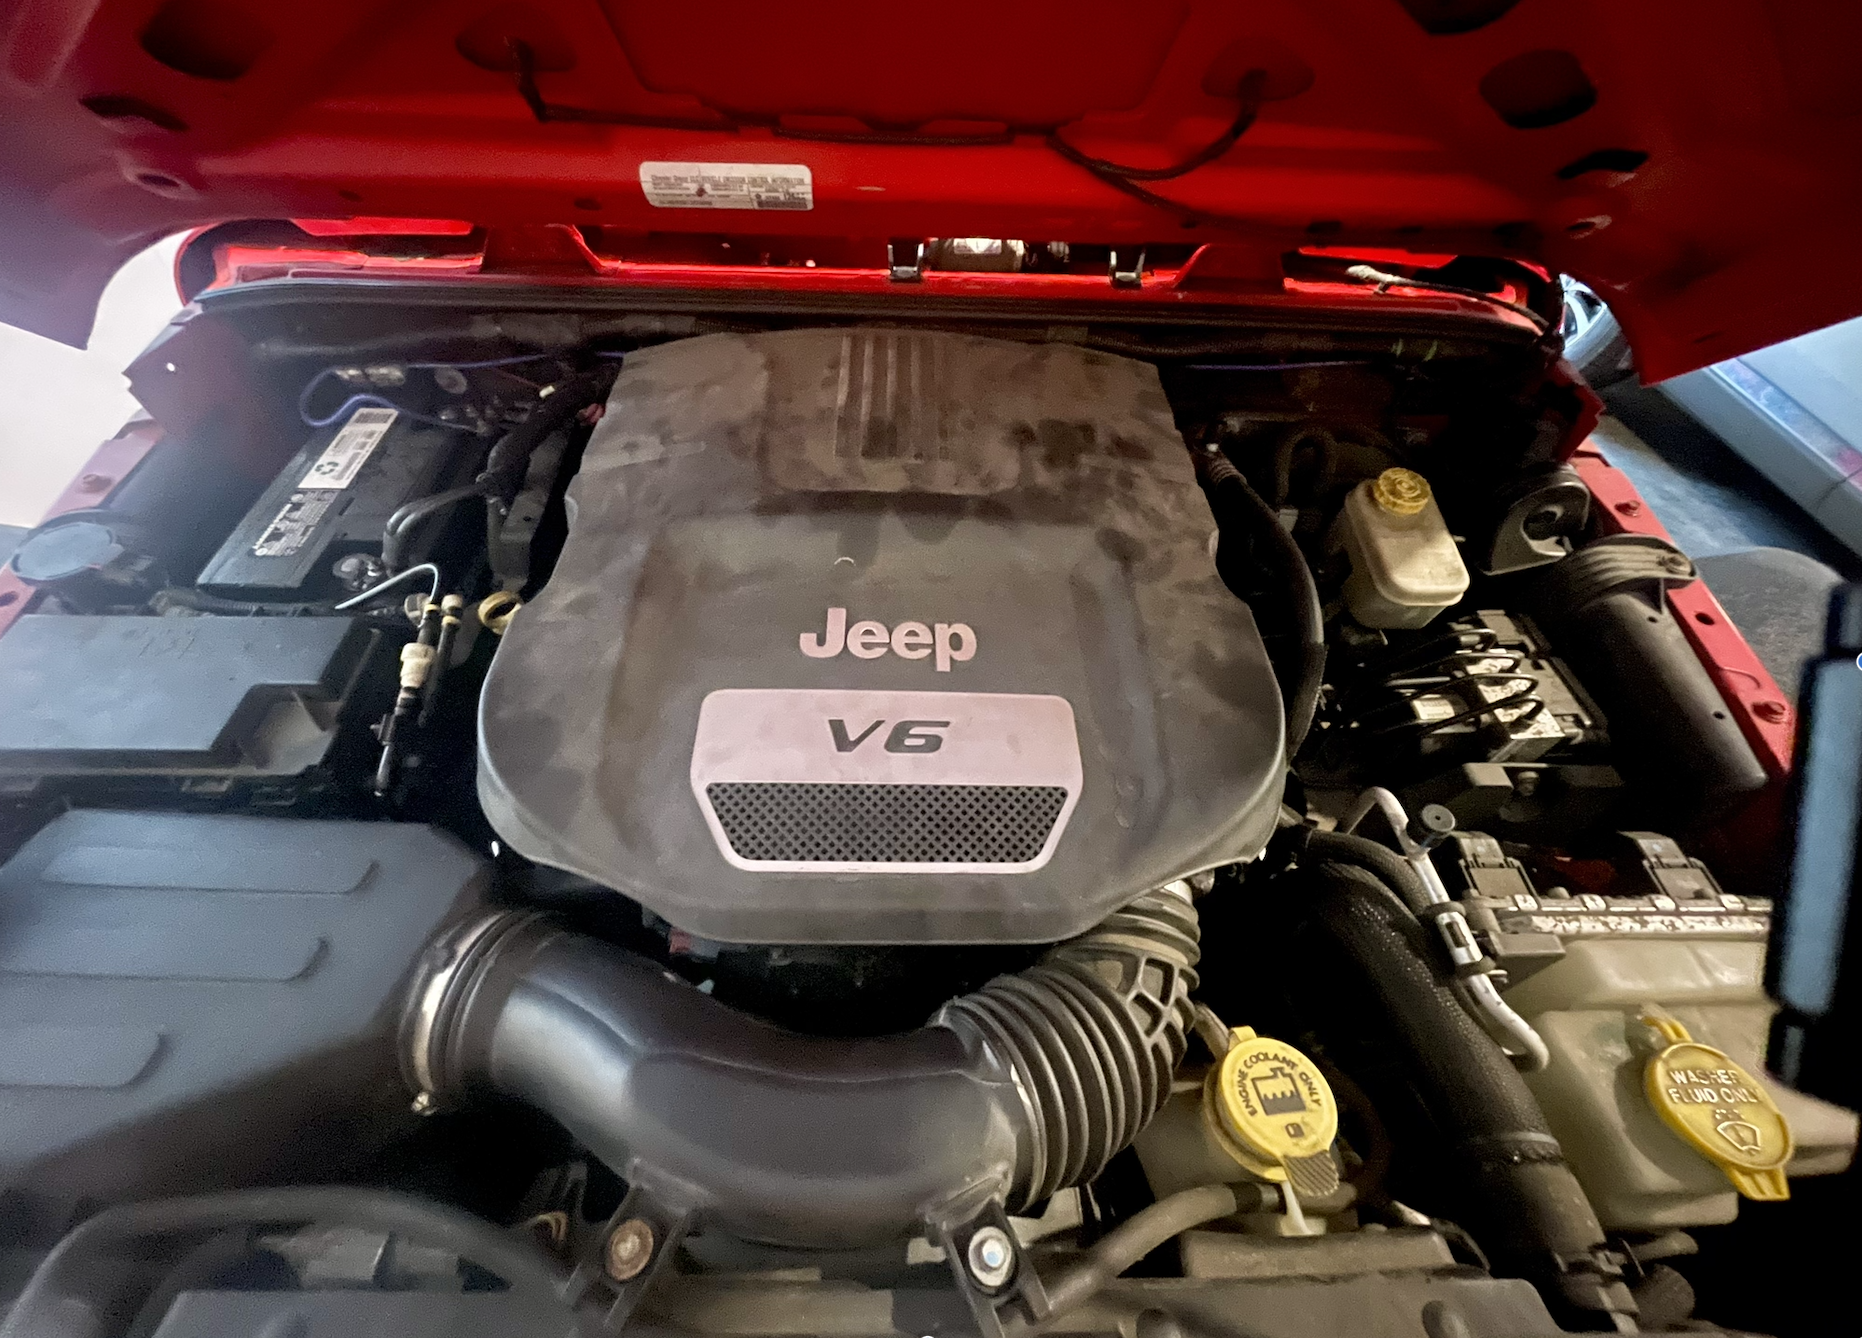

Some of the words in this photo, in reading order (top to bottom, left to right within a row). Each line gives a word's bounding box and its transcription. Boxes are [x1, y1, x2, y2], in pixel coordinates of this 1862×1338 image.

[799, 607, 977, 672] Jeep
[828, 719, 951, 753] V6
[1243, 1052, 1299, 1070] COOLANT
[1669, 1069, 1740, 1085] WASHER
[1238, 1068, 1258, 1117] ENGINE
[1298, 1071, 1322, 1107] ONLY
[1668, 1087, 1719, 1103] FLUID
[1719, 1087, 1760, 1103] ONLY
